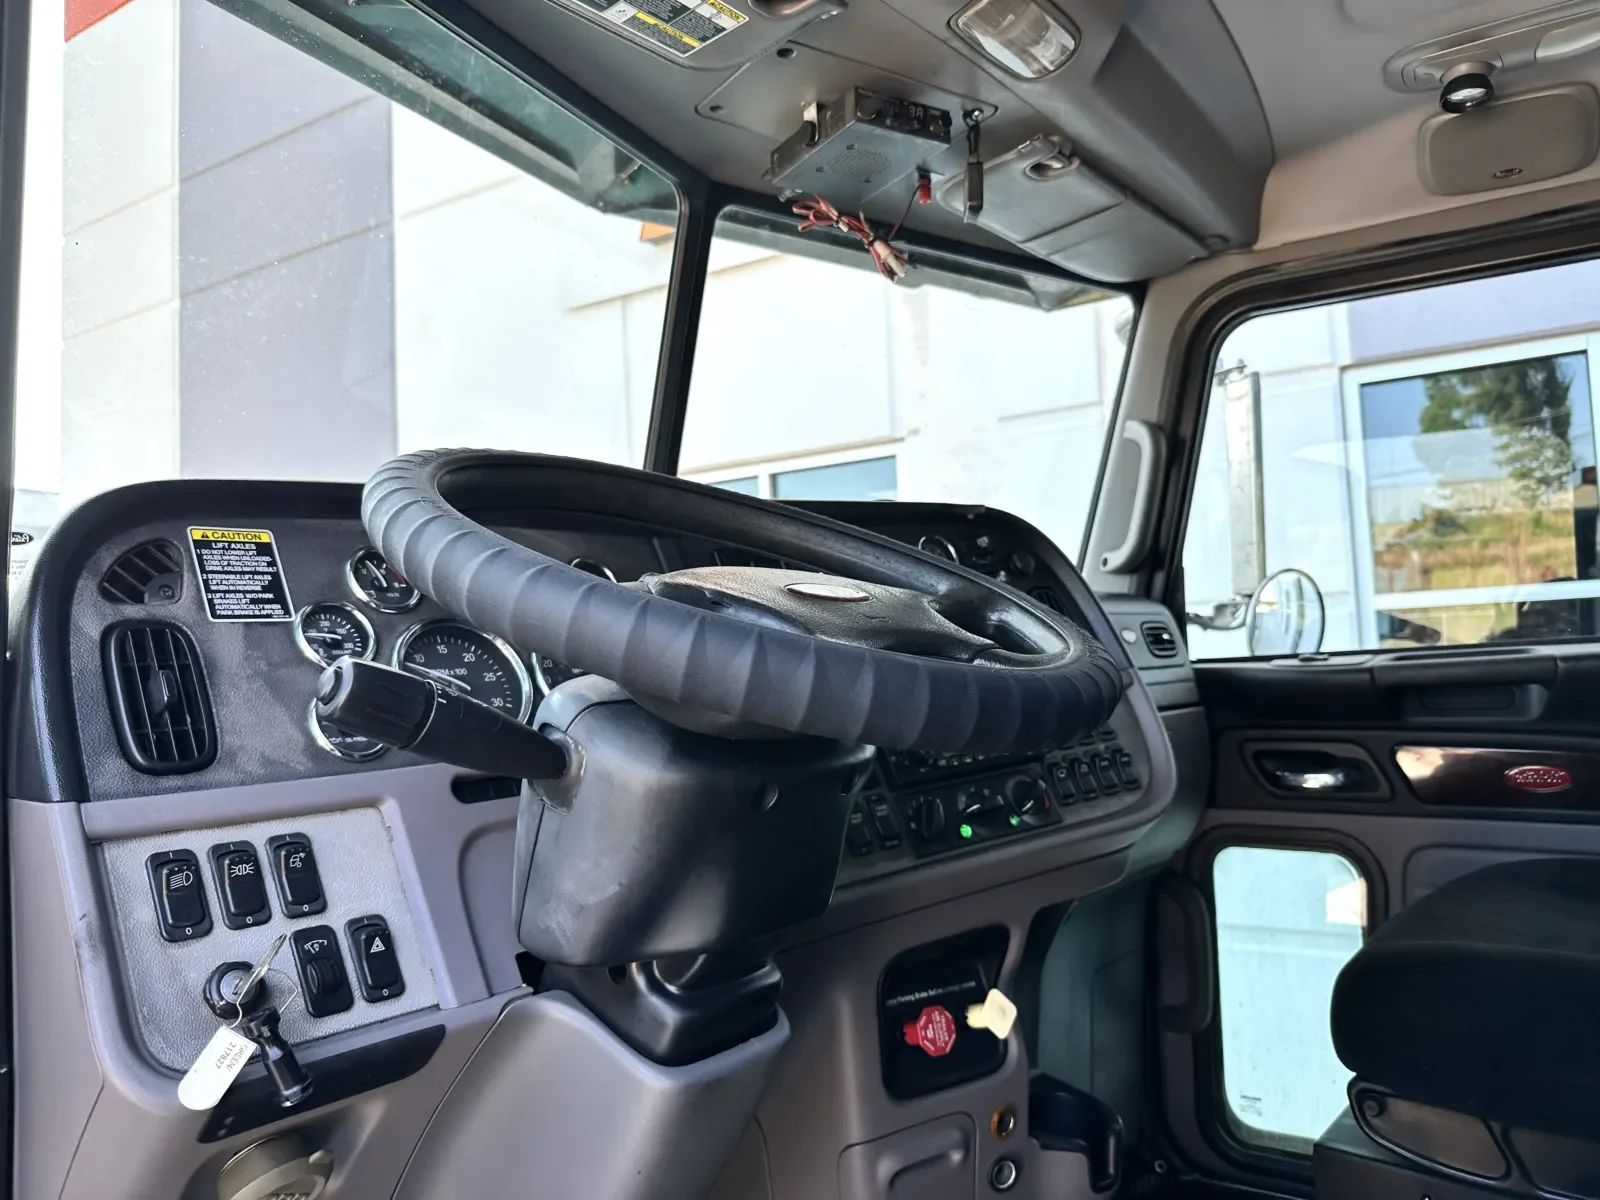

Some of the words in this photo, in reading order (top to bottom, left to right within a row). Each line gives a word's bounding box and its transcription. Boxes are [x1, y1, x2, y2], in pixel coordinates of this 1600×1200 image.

[714, 2, 740, 20] CAUTION
[212, 532, 262, 541] CAUTION
[436, 645, 448, 654] 15
[413, 654, 425, 663] 10
[462, 653, 475, 662] 20
[543, 659, 553, 668] 20
[483, 672, 496, 682] 25
[491, 697, 504, 707] 30
[215, 1041, 236, 1069] 217827
